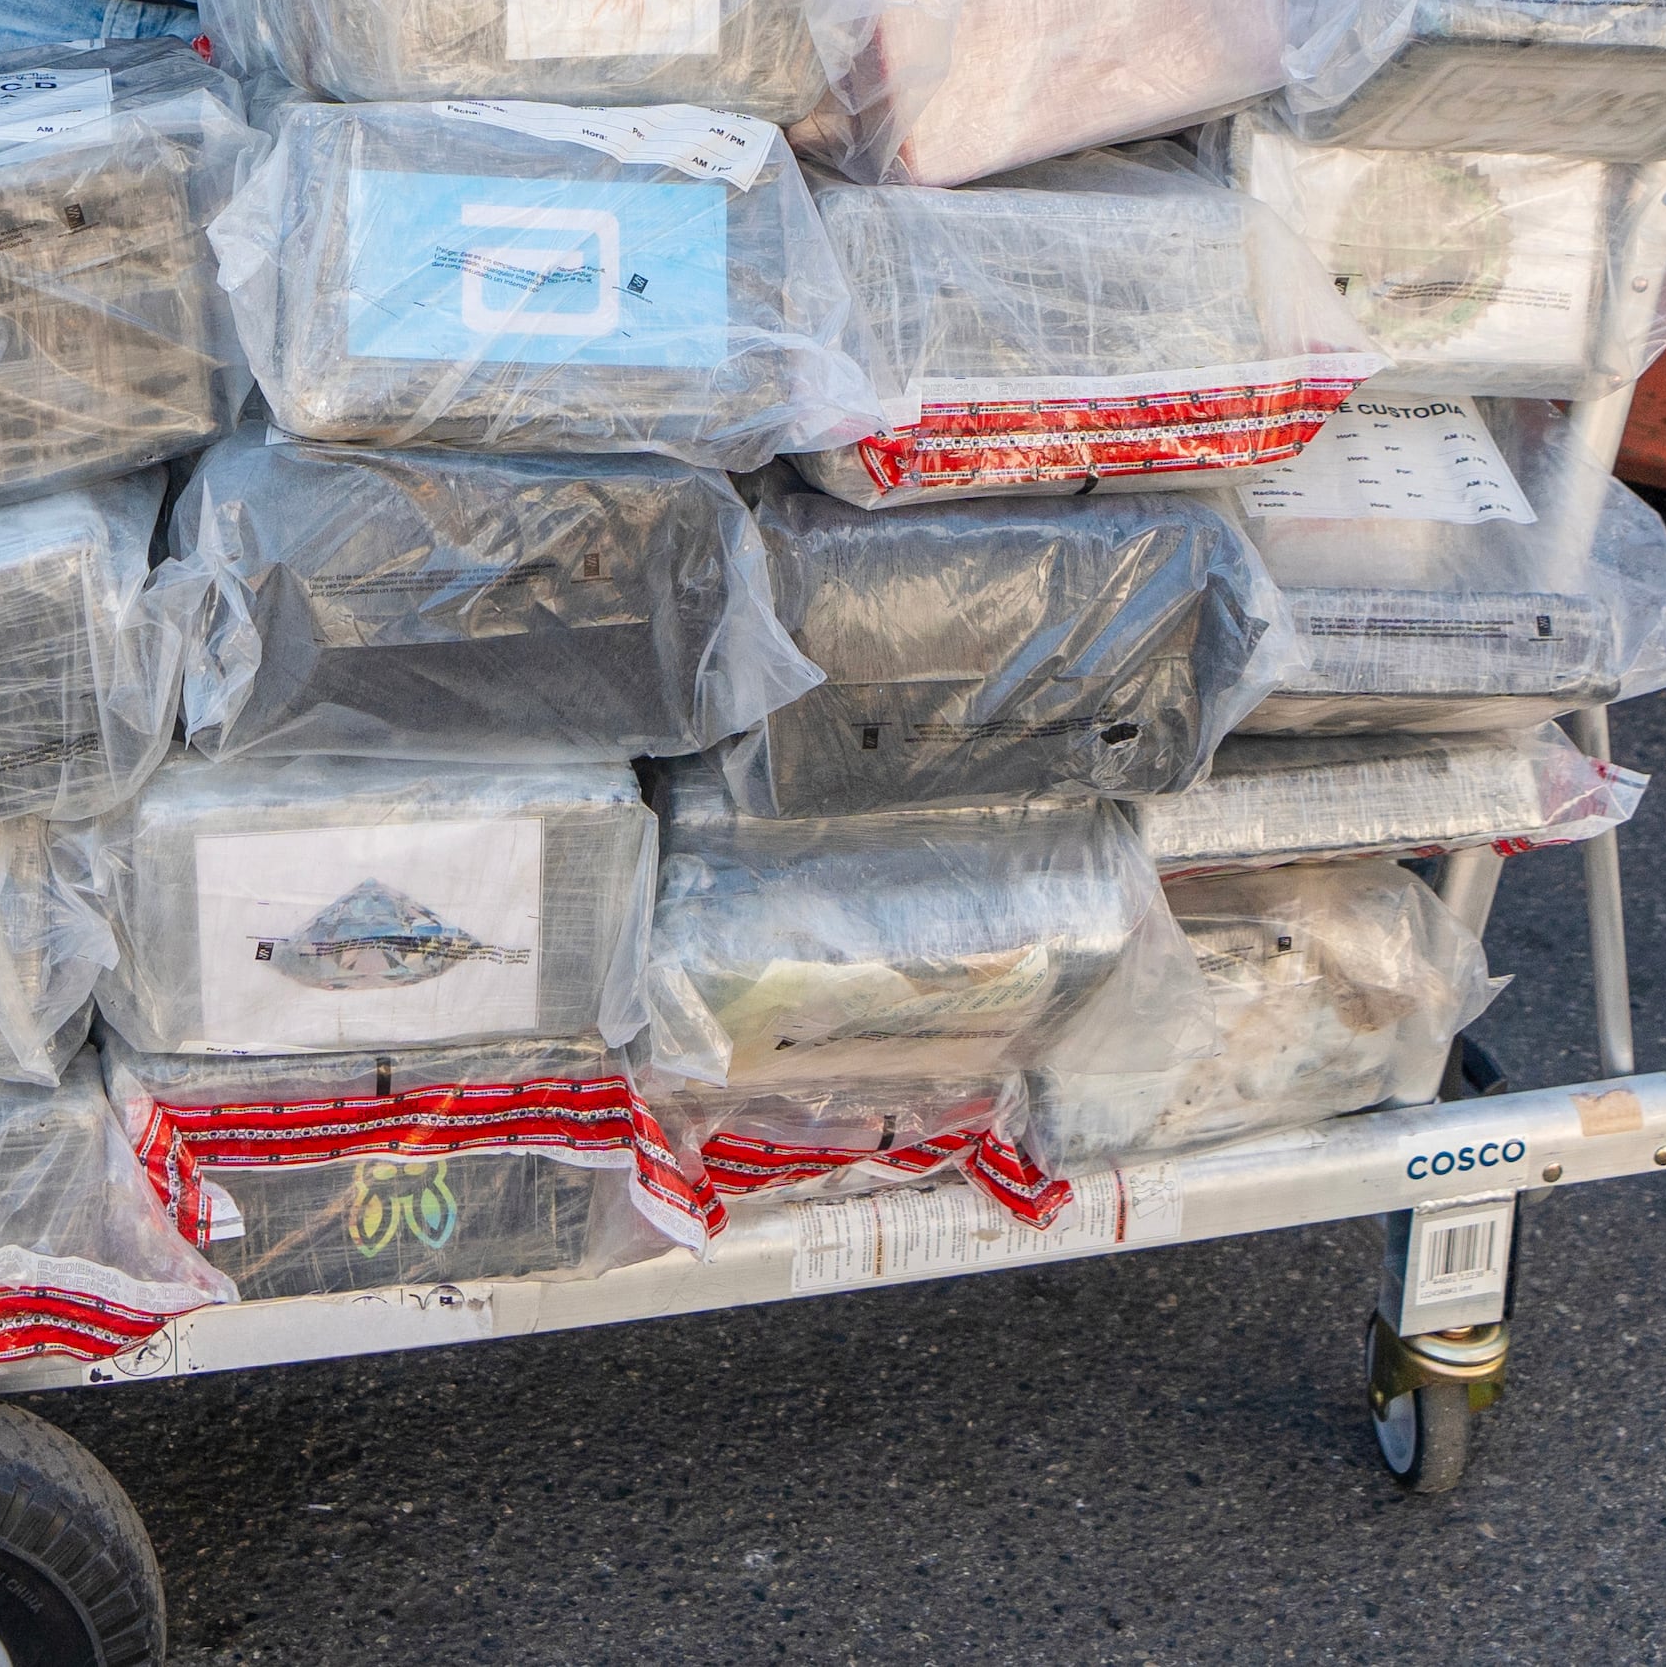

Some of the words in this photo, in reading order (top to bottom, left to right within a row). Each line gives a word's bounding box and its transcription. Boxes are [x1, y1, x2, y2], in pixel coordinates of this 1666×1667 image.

[447, 105, 481, 115] Fecha:
[709, 127, 724, 137] AM
[730, 135, 745, 147] PM
[582, 128, 609, 142] Hora:
[692, 156, 707, 168] AM
[482, 266, 515, 279] cualquier
[492, 260, 525, 274] empaque
[1358, 402, 1466, 419] CUSTODIA
[1374, 422, 1390, 430] Por:
[1444, 433, 1460, 441] AM
[1455, 456, 1470, 464] AM
[1466, 480, 1482, 488] AM
[1478, 505, 1493, 513] AM
[1407, 1138, 1525, 1180] COSCO
[5, 1578, 44, 1614] CHINA
